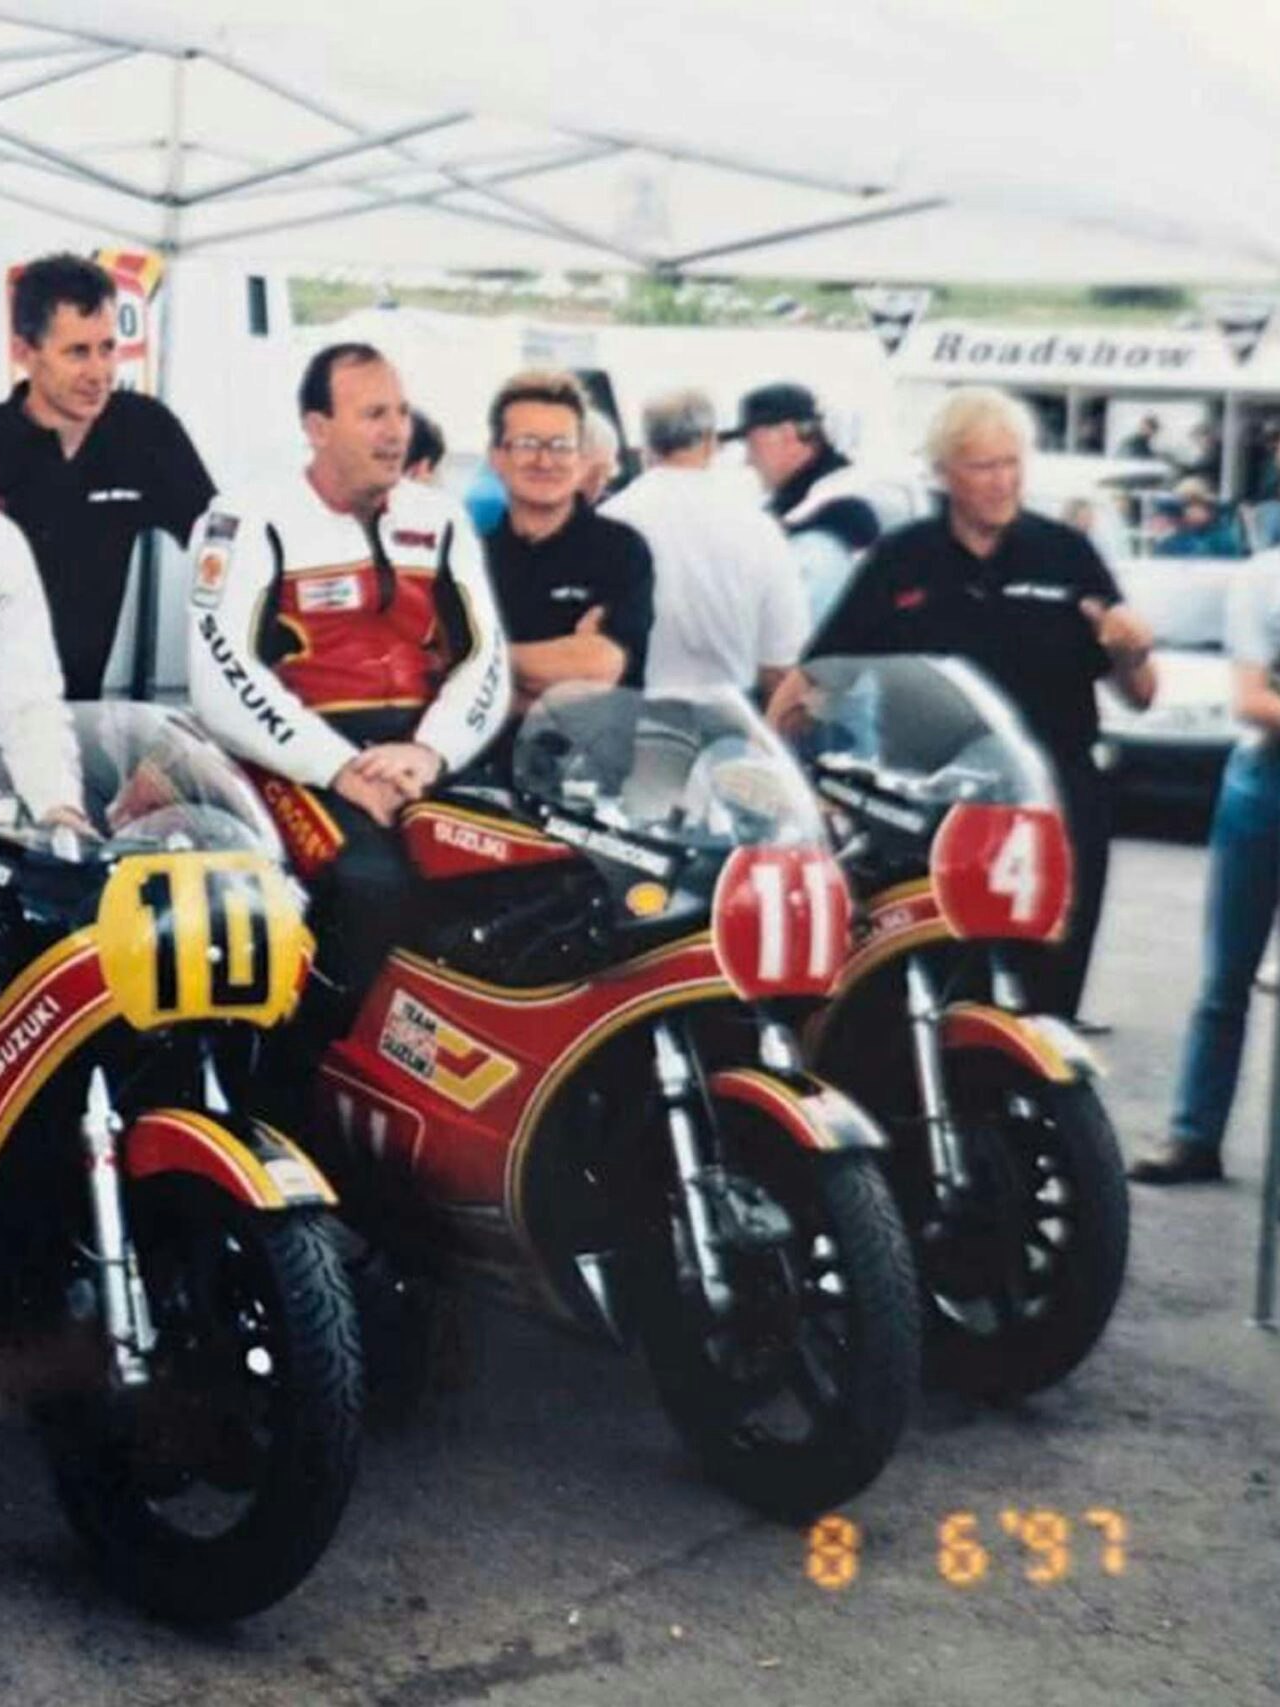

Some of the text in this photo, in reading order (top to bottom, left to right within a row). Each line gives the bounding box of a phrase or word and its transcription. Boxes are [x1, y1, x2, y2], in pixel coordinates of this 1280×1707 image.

[931, 332, 1193, 369] Roadshow
[198, 614, 295, 745] SUZUKI
[752, 859, 833, 981] 11
[986, 815, 1038, 922] 4
[138, 868, 272, 1012] 10
